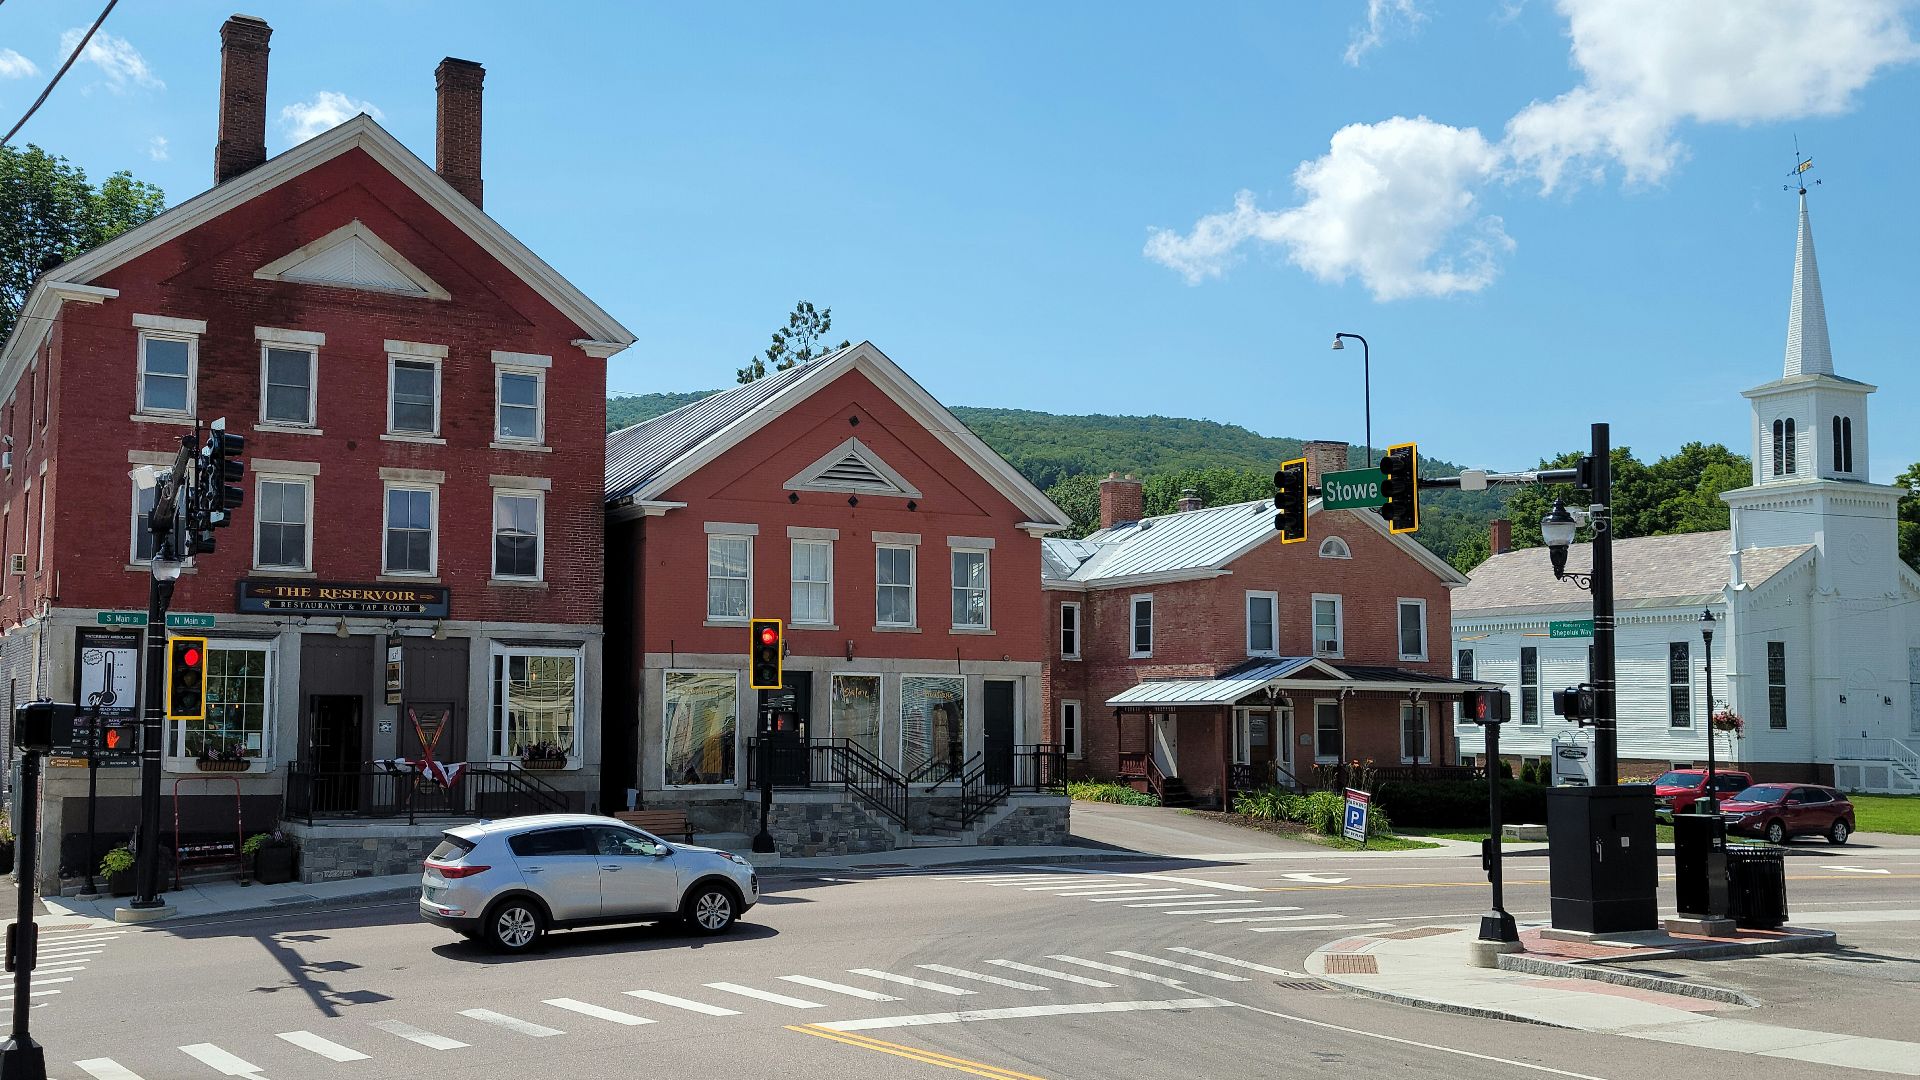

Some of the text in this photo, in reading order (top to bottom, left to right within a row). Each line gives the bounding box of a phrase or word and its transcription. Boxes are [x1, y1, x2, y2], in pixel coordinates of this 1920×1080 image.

[1326, 480, 1378, 502] Stowe
[274, 586, 416, 601] THE RESERVOIR
[280, 601, 343, 610] RESTAURANT
[383, 604, 411, 612] ROOM
[115, 614, 130, 623] Main
[183, 617, 199, 625] Main
[1580, 628, 1593, 637] Way
[1351, 810, 1360, 824] P
